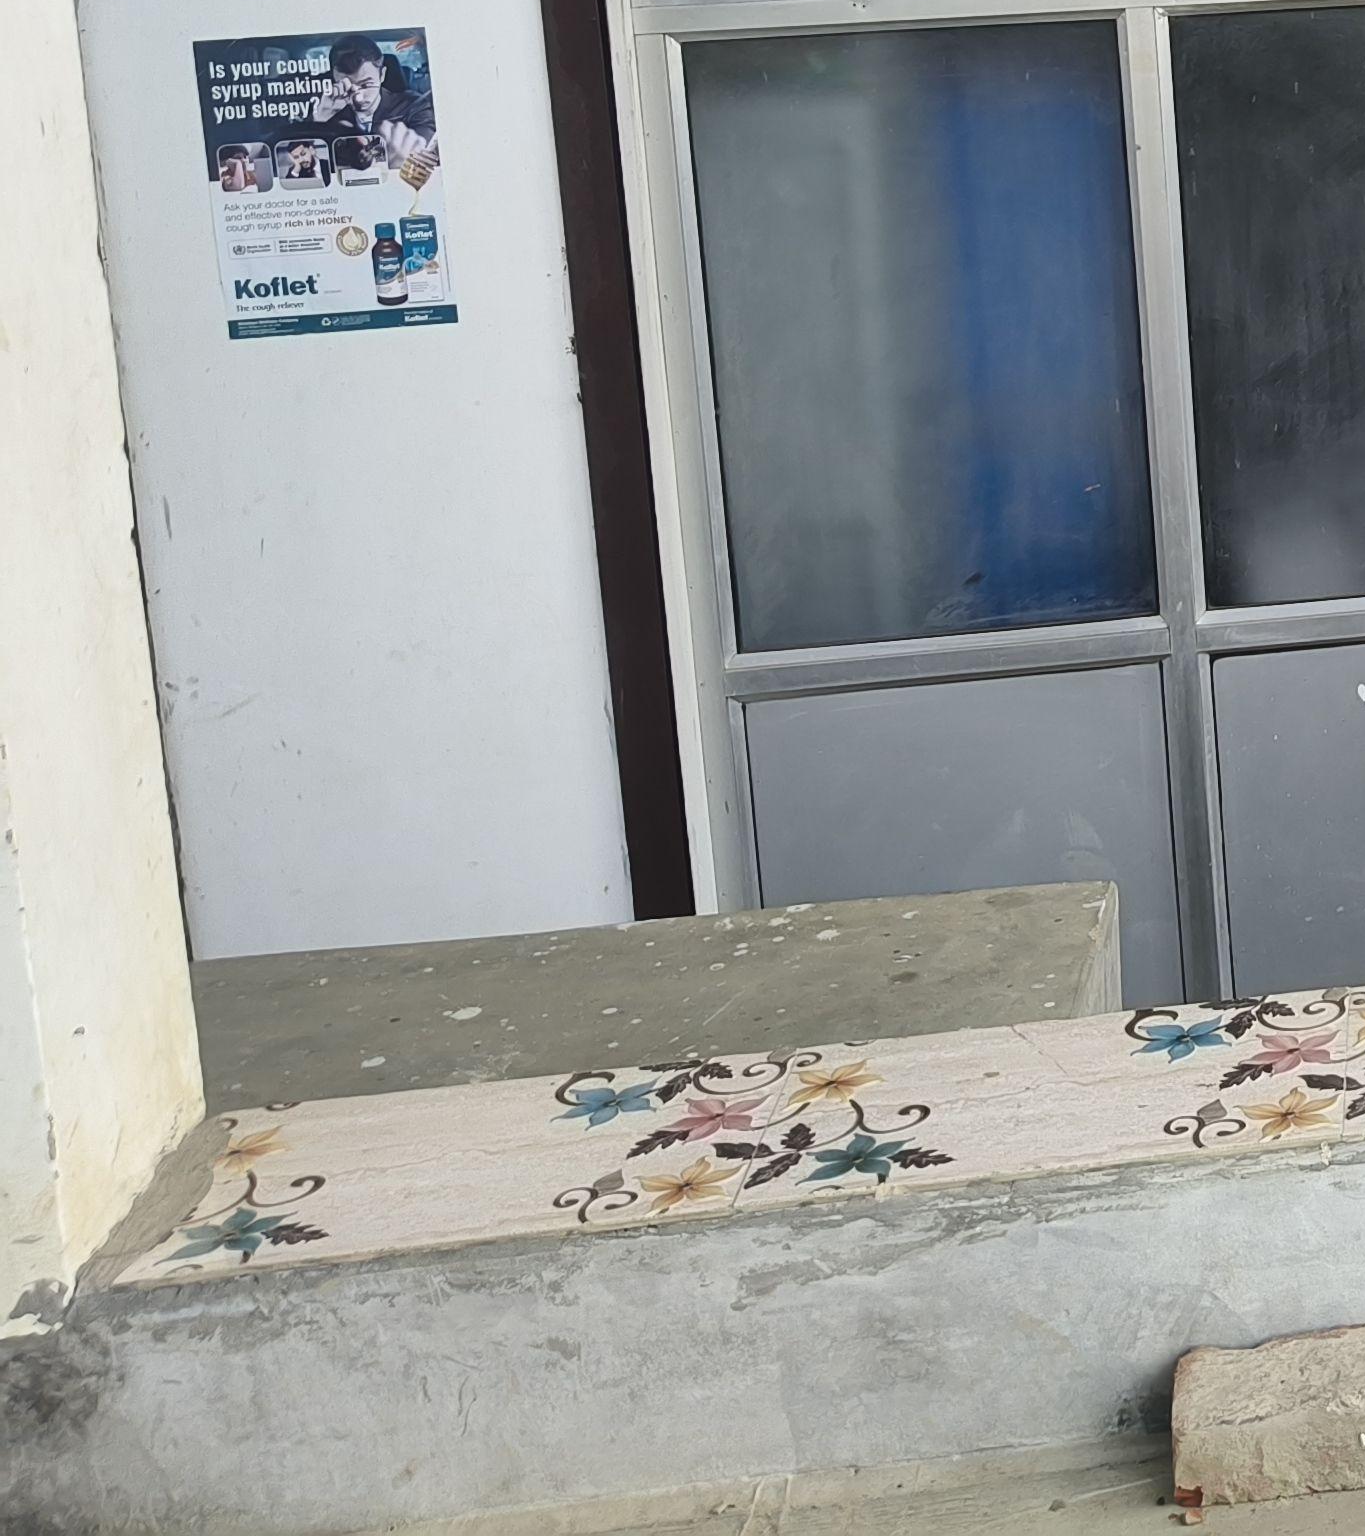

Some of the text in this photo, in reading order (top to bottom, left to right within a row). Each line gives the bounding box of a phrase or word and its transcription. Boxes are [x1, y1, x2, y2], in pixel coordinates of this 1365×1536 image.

[209, 54, 331, 81] Is your cough
[211, 77, 333, 103] syrup making
[213, 96, 320, 124] you sleepy?
[243, 201, 263, 211] your
[310, 198, 317, 206] a
[225, 213, 243, 222] and
[226, 215, 353, 233] cough syrup rich in HONEY
[234, 275, 319, 300] Koflet
